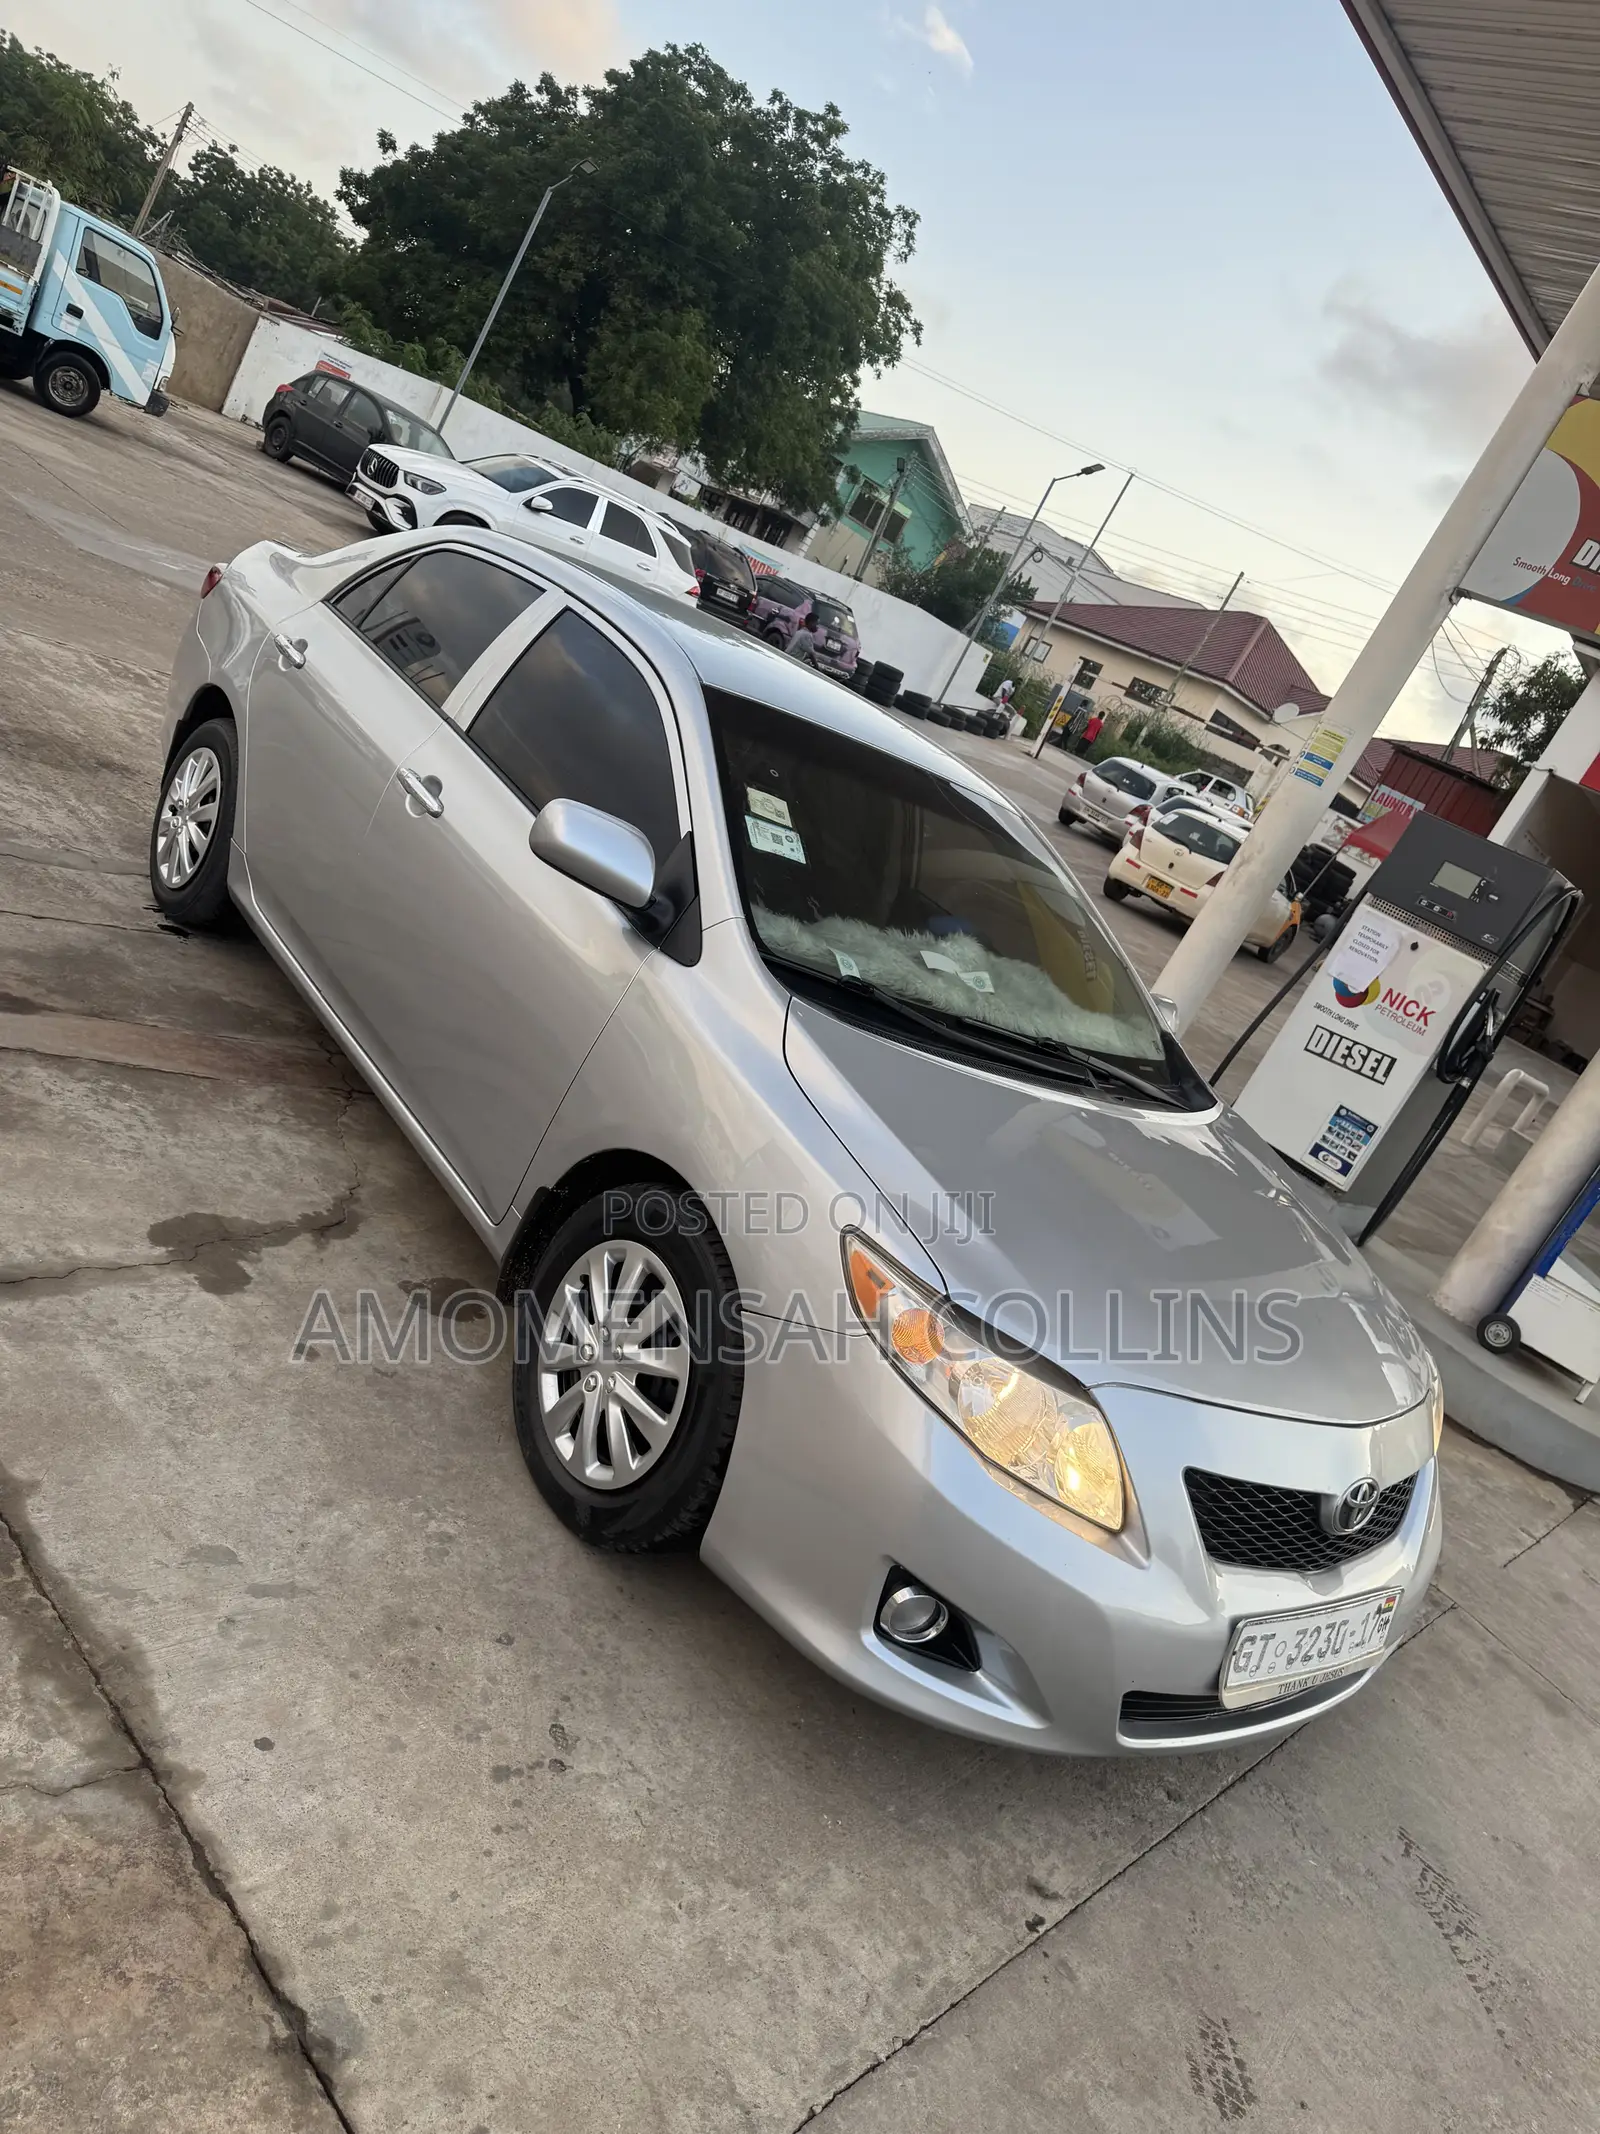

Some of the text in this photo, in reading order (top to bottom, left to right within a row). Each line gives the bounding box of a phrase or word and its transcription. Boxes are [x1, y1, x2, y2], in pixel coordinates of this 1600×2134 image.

[1513, 556, 1547, 575] Smooth
[1547, 567, 1571, 586] Long
[1361, 924, 1382, 938] STATION
[1352, 938, 1380, 956] CLOSED FOR
[1313, 1001, 1360, 1031] SMOOTH LONG DRIVE
[1374, 1004, 1427, 1037] PETROLEUM
[1381, 987, 1437, 1027] NICK
[1304, 1025, 1396, 1085] DIESEL
[1278, 1676, 1309, 1695] THANK
[1318, 1668, 1345, 1684] JESUS
